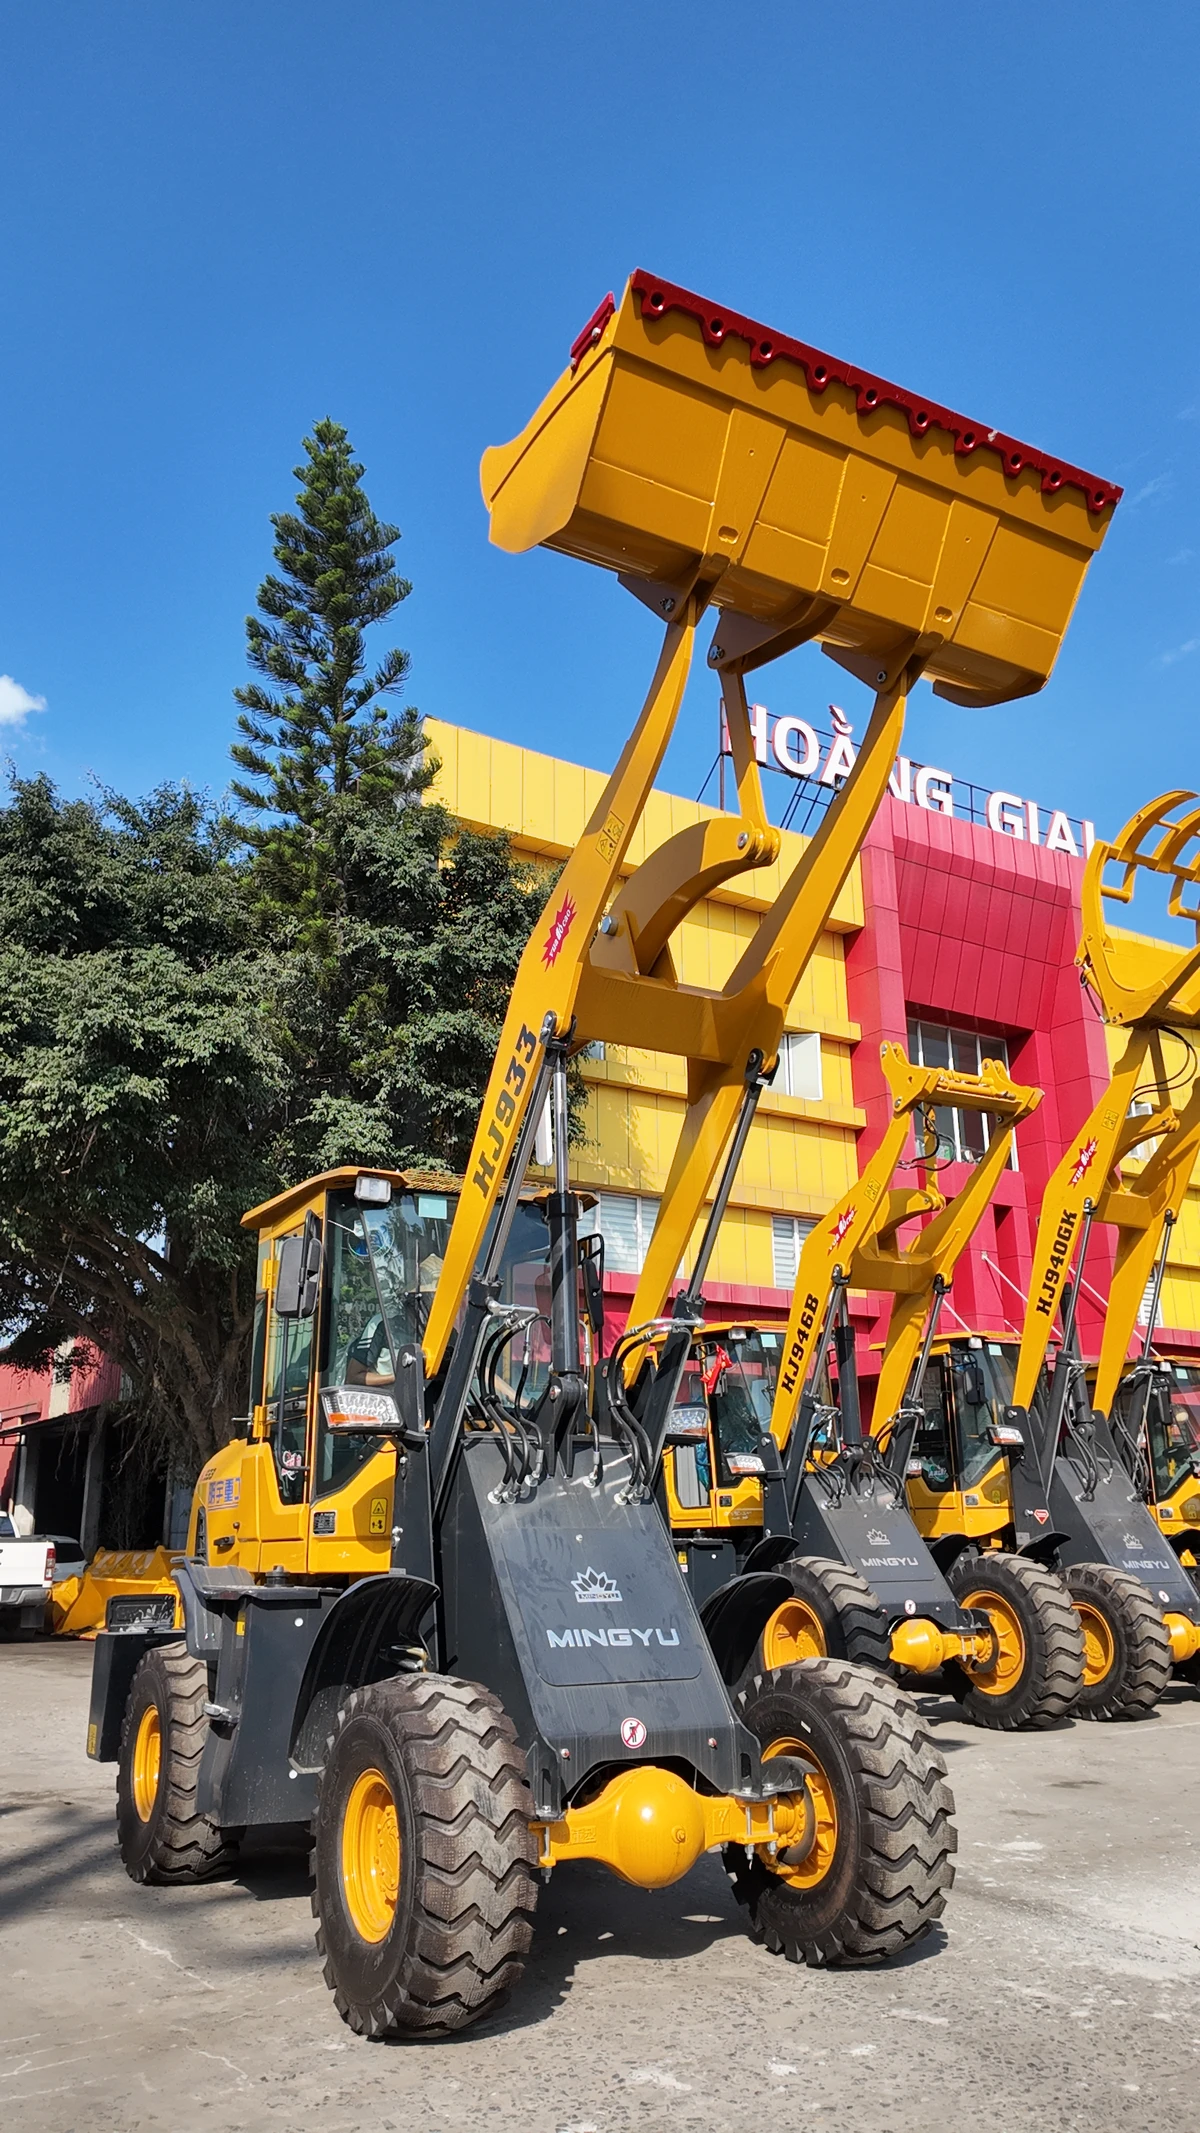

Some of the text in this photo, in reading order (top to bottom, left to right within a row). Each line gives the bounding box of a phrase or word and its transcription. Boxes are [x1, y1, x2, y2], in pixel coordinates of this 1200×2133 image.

[472, 1023, 537, 1199] HJ933
[1036, 1209, 1077, 1316] HJ940GK
[781, 1293, 819, 1394] HJ946B
[860, 1557, 919, 1567] MINGYU
[1122, 1560, 1170, 1569] MINGYU
[546, 1628, 680, 1648] MINGYU
